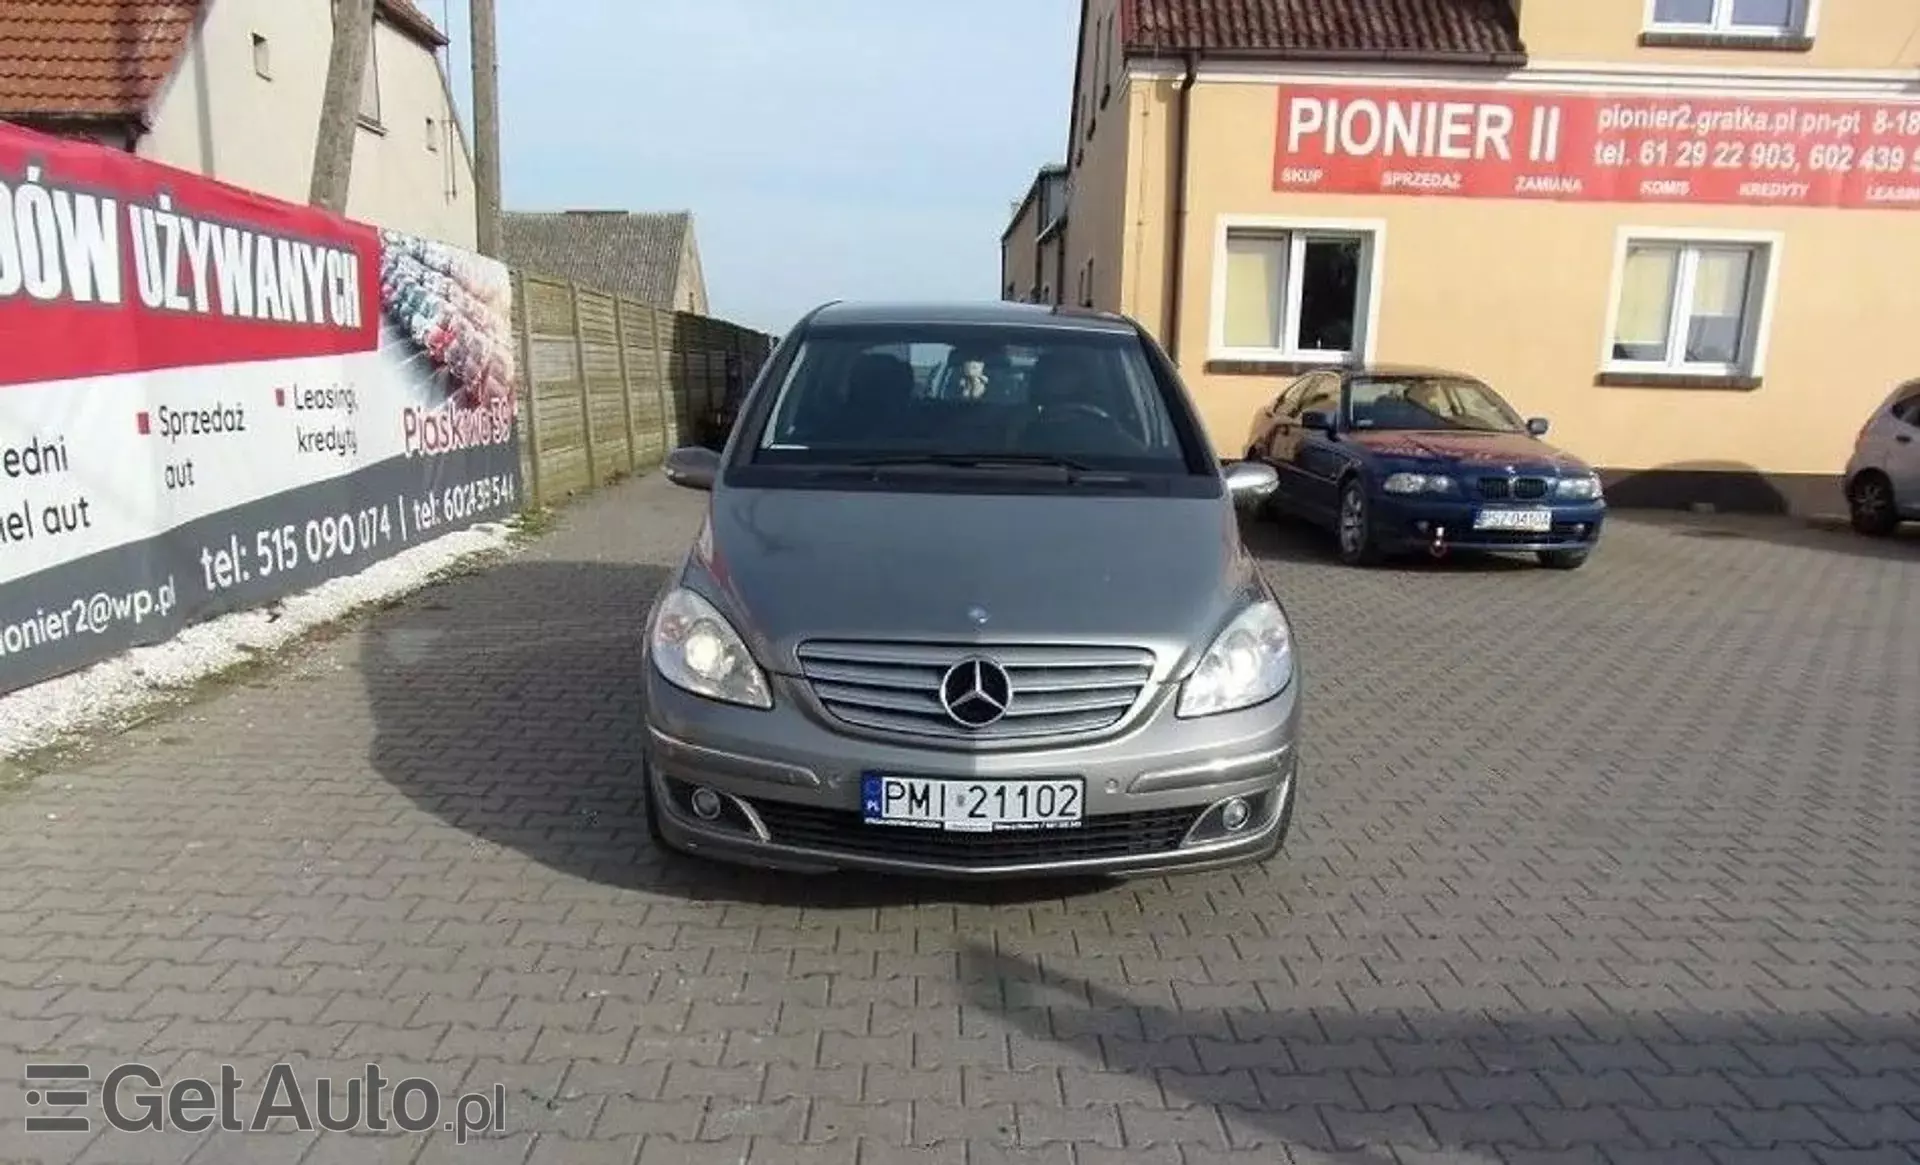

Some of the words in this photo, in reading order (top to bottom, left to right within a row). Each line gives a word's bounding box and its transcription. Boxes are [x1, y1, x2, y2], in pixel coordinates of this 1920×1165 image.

[1287, 96, 1512, 160] PIONIER
[1529, 106, 1560, 161] II
[1595, 139, 1632, 167] tel.
[1639, 140, 1668, 167] 61
[1674, 141, 1706, 168] 29
[1712, 142, 1744, 168] 22
[1808, 145, 1854, 171] 602
[1858, 145, 1905, 173] 439
[1281, 167, 1323, 185] SKUP
[128, 193, 362, 329] UŻYWANYCH
[159, 401, 245, 444] Sprzedaż
[165, 459, 195, 490] aut
[43, 496, 90, 535] aut
[200, 533, 249, 590] tel:
[256, 525, 298, 576] 515
[305, 513, 355, 563] 090
[358, 504, 391, 549] 074
[885, 781, 946, 816] PMI
[968, 784, 1079, 819] 21102
